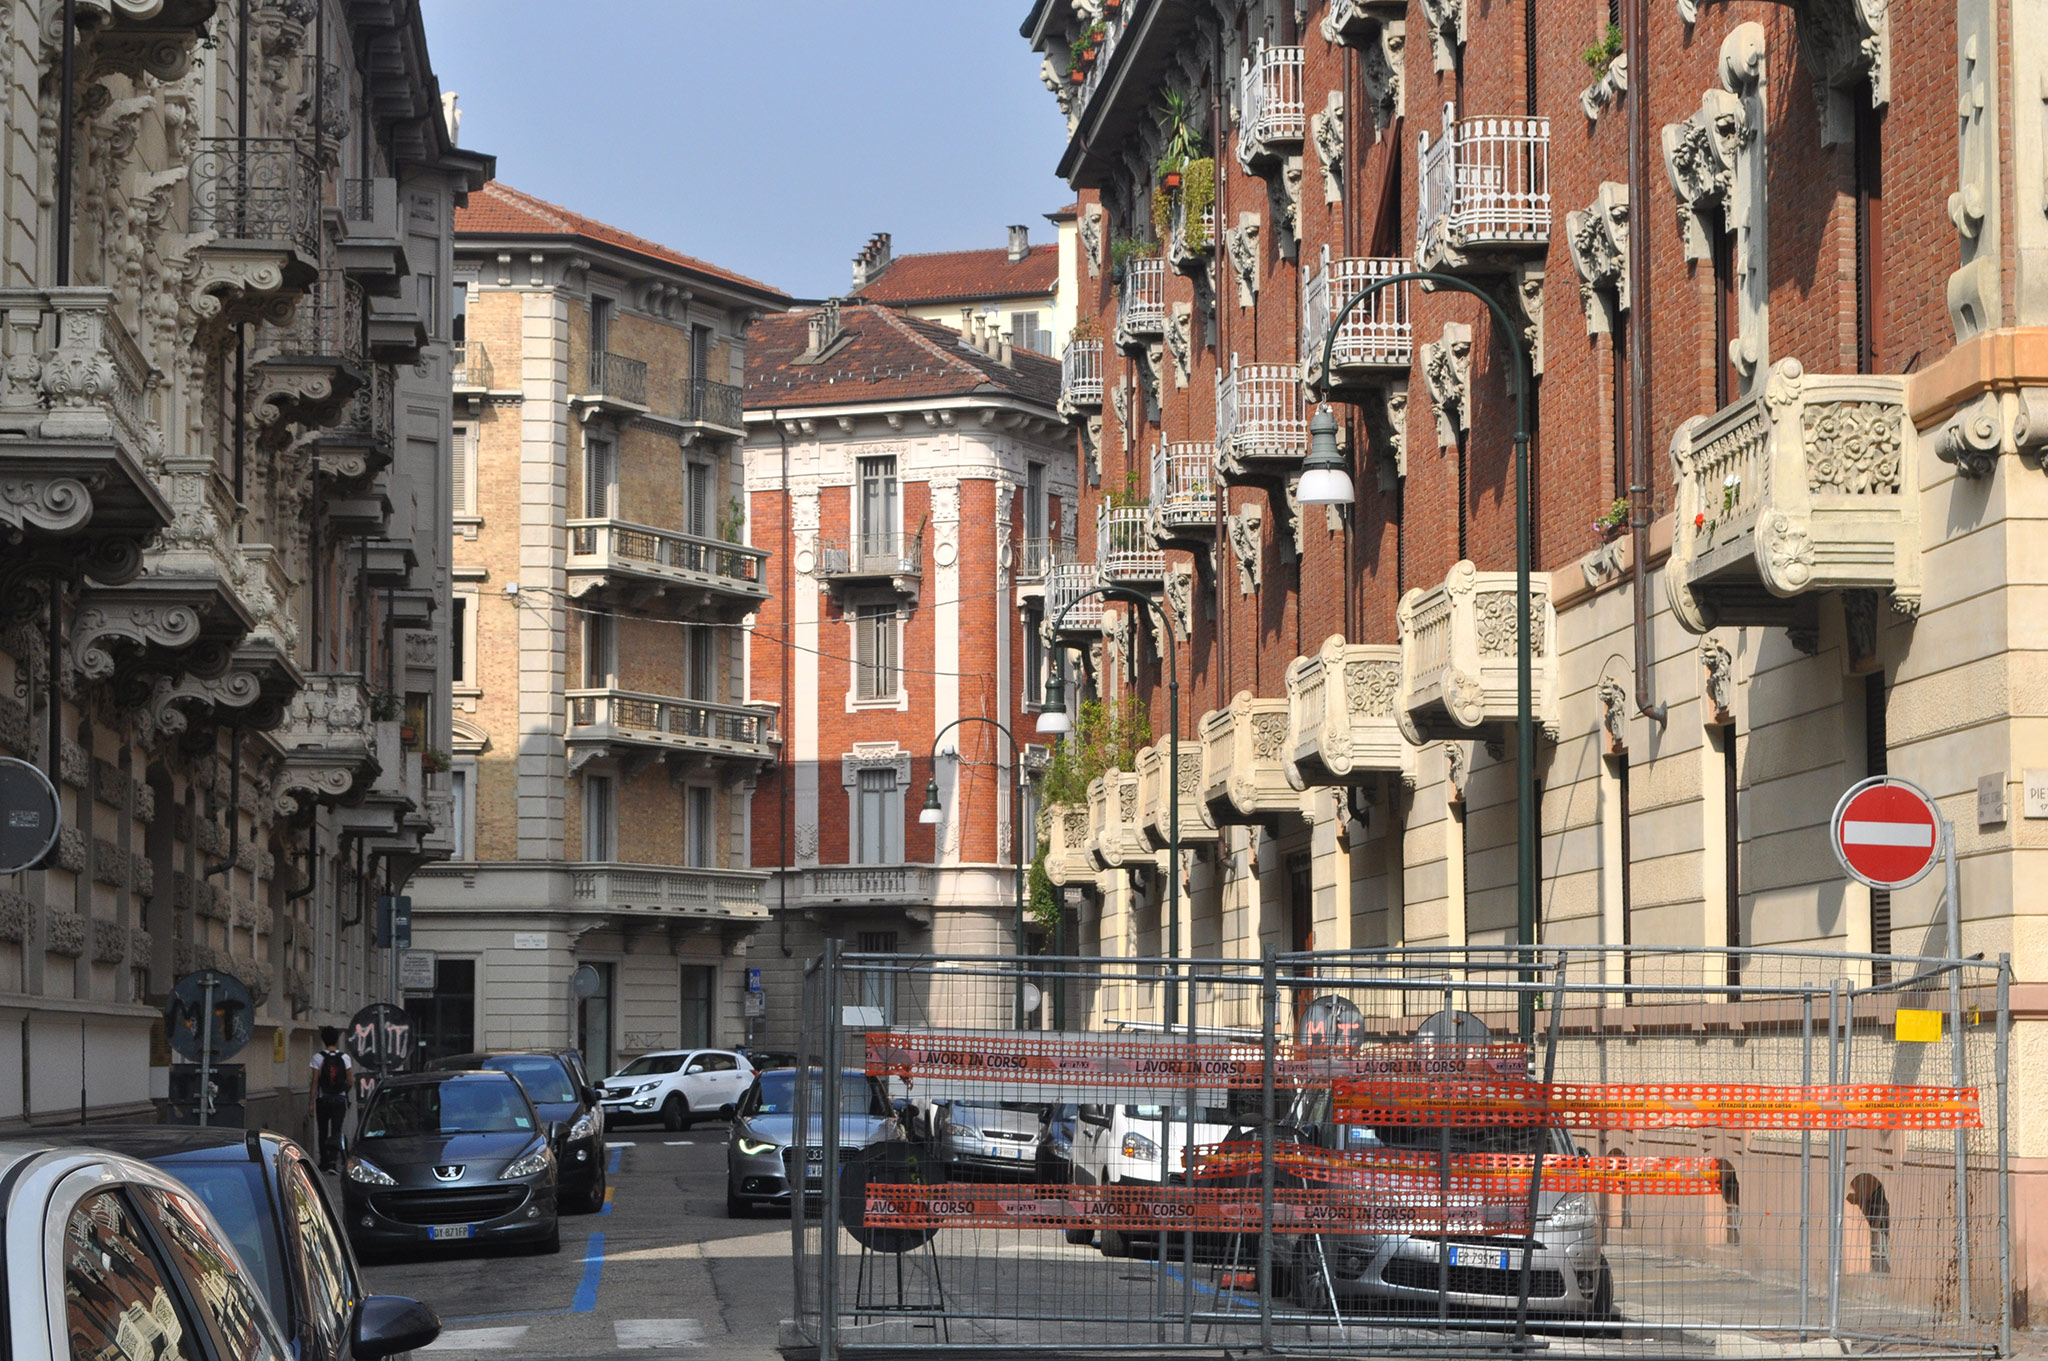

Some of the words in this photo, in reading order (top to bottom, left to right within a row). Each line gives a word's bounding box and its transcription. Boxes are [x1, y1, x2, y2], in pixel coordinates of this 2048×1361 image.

[2030, 787, 2048, 800] PIE
[918, 1052, 964, 1066] LAVORI
[969, 1054, 983, 1067] IN
[986, 1055, 1028, 1069] CORSO
[1135, 1060, 1183, 1073] LAVORI
[1187, 1061, 1201, 1073] IN
[1205, 1061, 1247, 1074] CORSO
[1355, 1061, 1404, 1074] LAVORI
[1407, 1061, 1422, 1073] IN
[1424, 1060, 1466, 1073] CORSO
[915, 1201, 930, 1214] IN
[933, 1201, 975, 1214] CORSO
[1084, 1202, 1131, 1216] LAVORI
[1136, 1203, 1150, 1216] IN
[1153, 1204, 1195, 1217] CORSO
[1304, 1206, 1351, 1219] LAVORI
[1355, 1207, 1371, 1219] IN
[1374, 1208, 1416, 1221] CORSO
